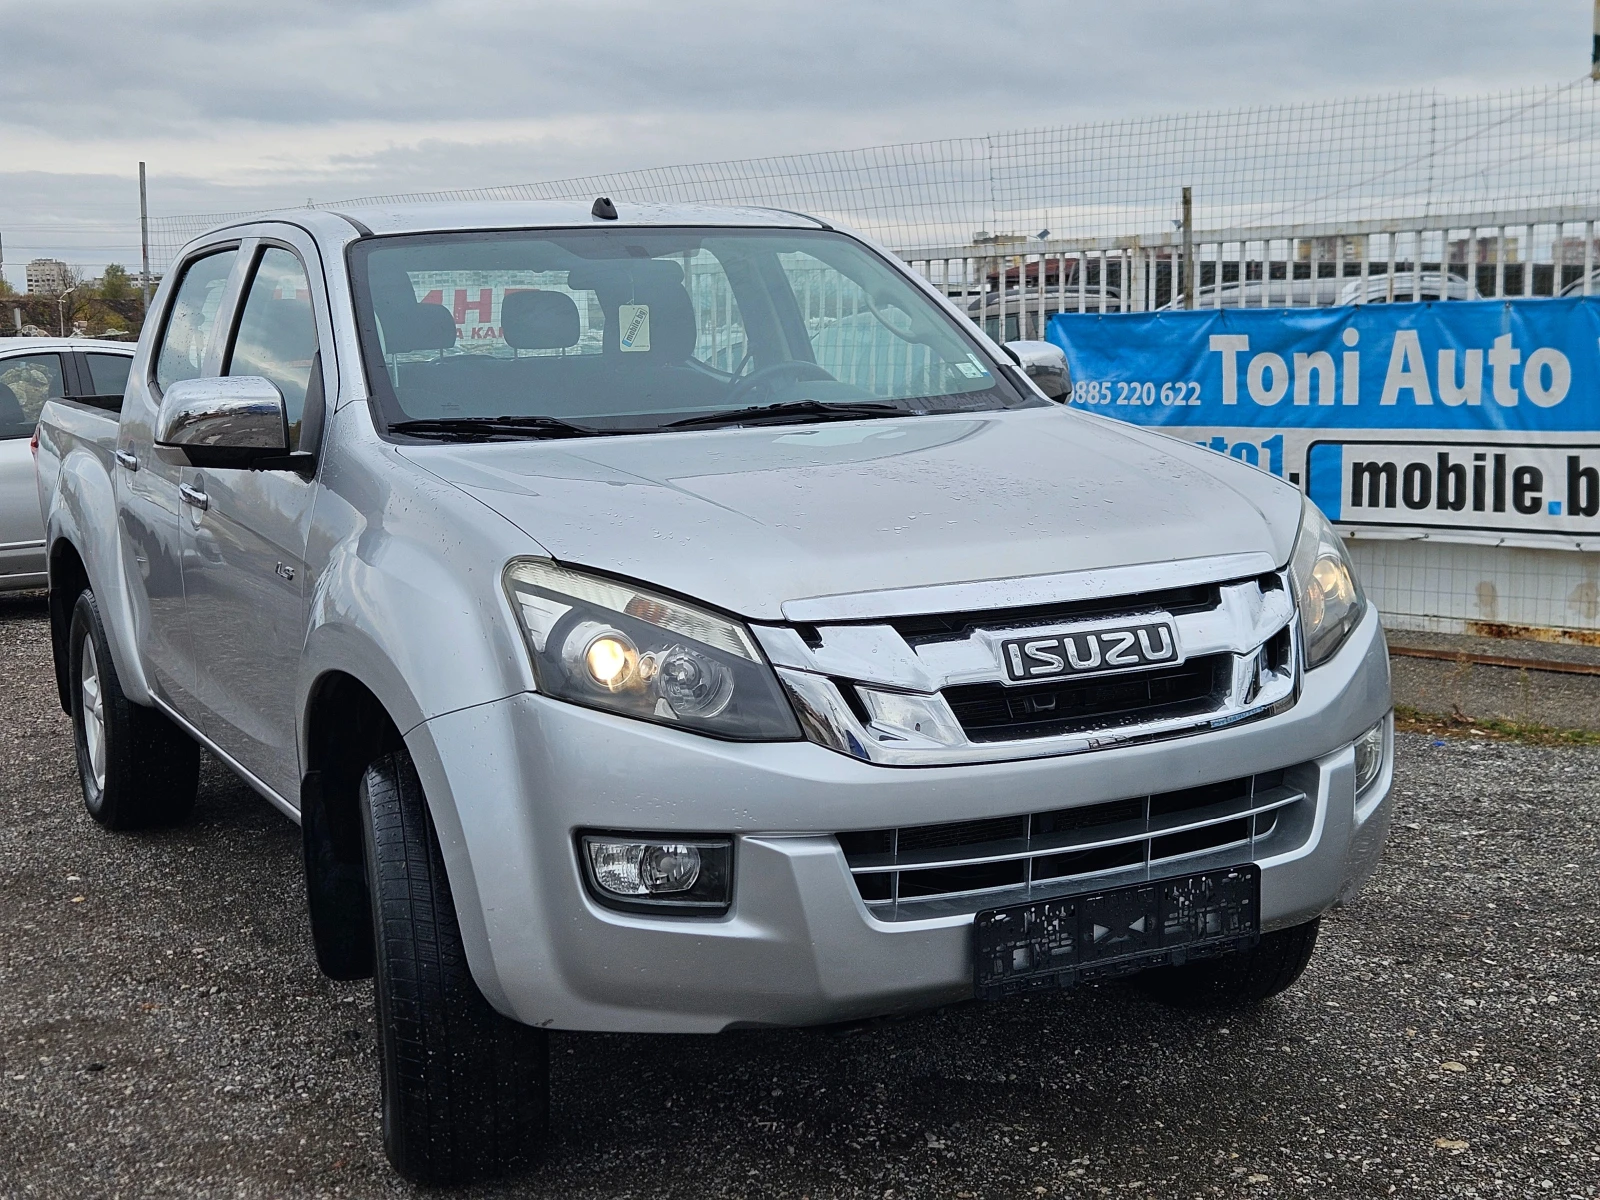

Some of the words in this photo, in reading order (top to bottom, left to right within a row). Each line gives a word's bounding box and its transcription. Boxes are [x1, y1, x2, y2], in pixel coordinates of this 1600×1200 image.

[625, 310, 647, 342] mobile.bg
[1209, 327, 1361, 406] Toni
[1379, 329, 1572, 409] Auto
[1116, 381, 1156, 406] 220
[1160, 381, 1202, 406] 622
[1007, 626, 1172, 677] ISUZU
